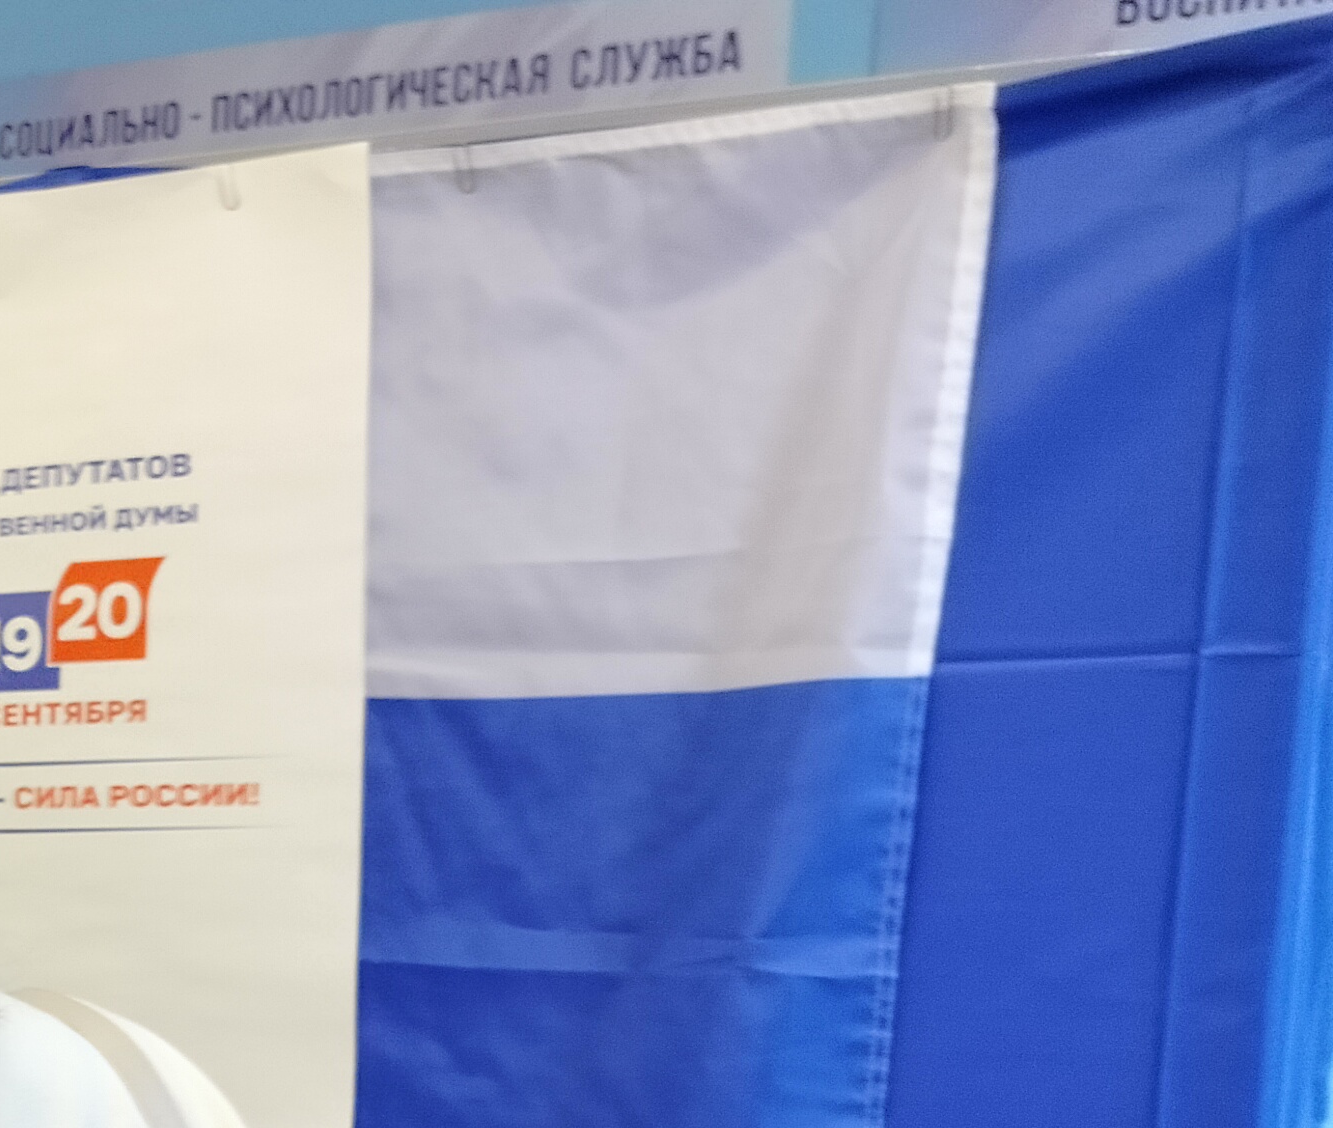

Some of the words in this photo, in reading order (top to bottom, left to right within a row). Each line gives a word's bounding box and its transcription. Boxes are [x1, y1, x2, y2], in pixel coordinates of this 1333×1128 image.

[211, 53, 551, 135] ПСИХОЛОГИЧЕСКАЯ
[569, 29, 744, 90] СЛУЖБА
[0, 453, 192, 495] ДЕПУТАТОВ
[113, 503, 199, 531] ДУМЫ
[56, 580, 144, 642] 20
[13, 785, 101, 811] СИЛА
[108, 782, 261, 810] РОССИИ!
